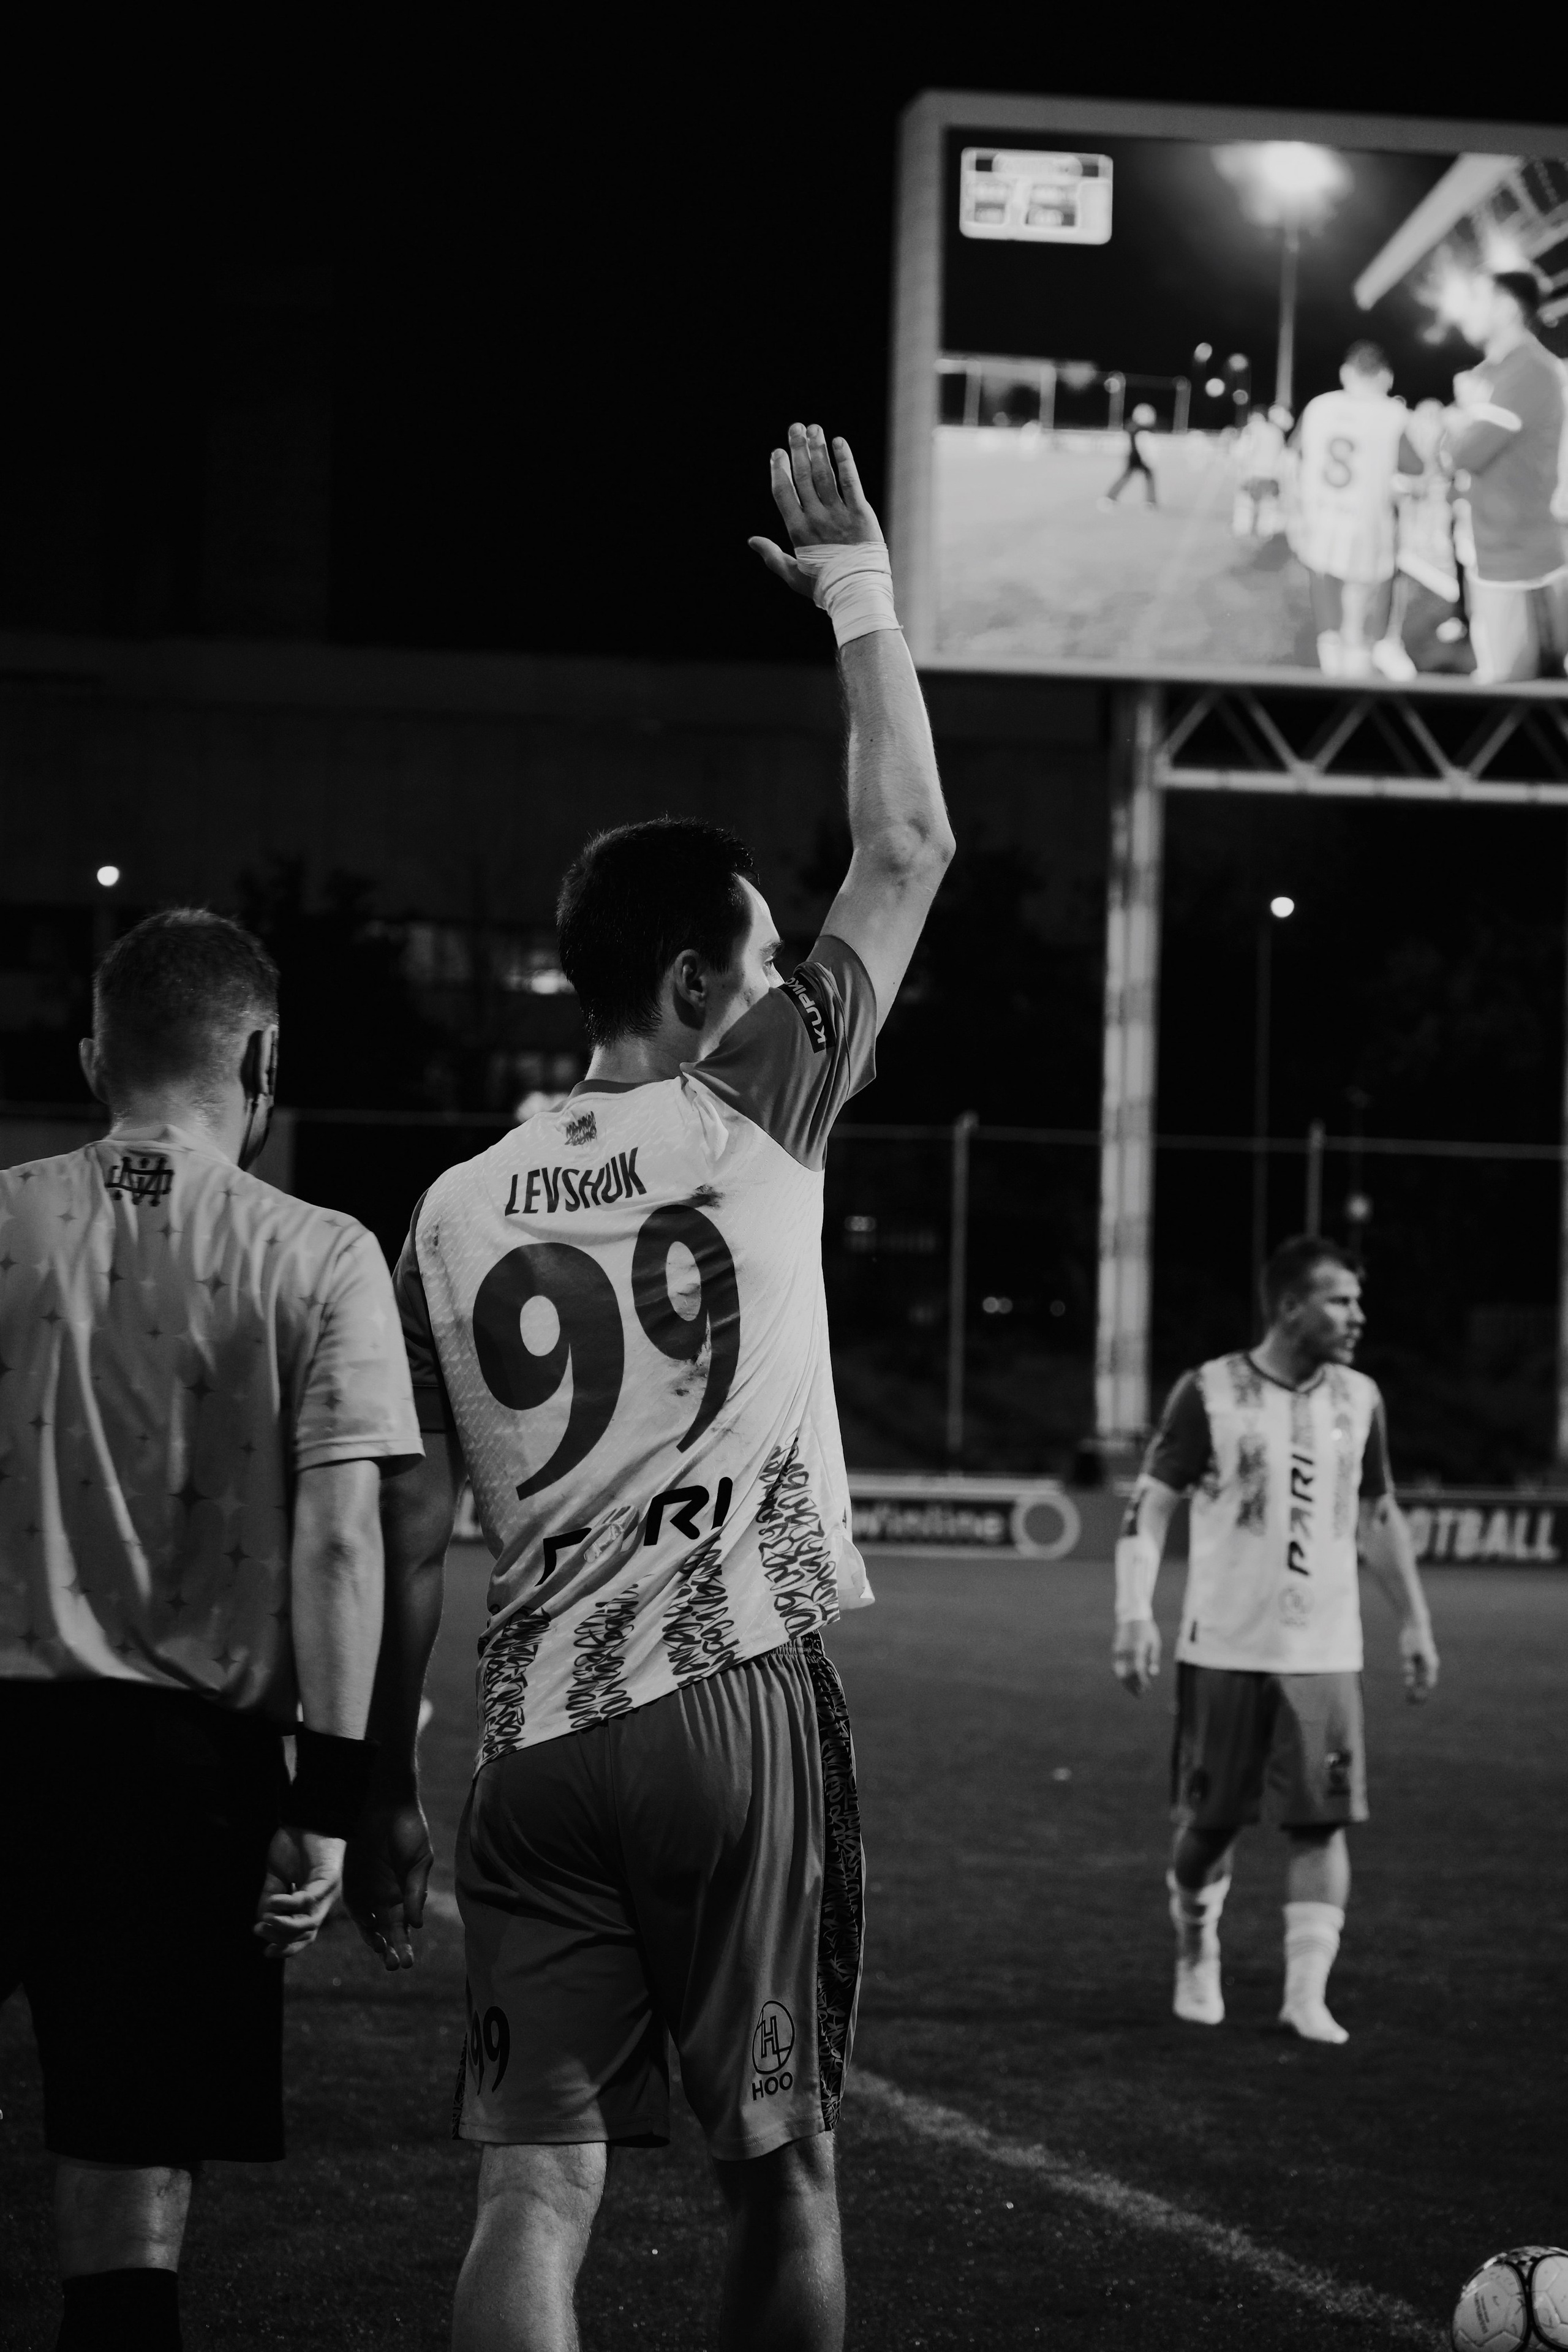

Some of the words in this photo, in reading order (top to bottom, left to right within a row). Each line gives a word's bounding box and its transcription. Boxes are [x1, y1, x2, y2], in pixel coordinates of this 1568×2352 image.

[505, 1147, 647, 1216] LEVSHUK
[472, 1204, 740, 1501] 99
[470, 2005, 510, 2096] 99
[752, 2071, 793, 2100] HOO
